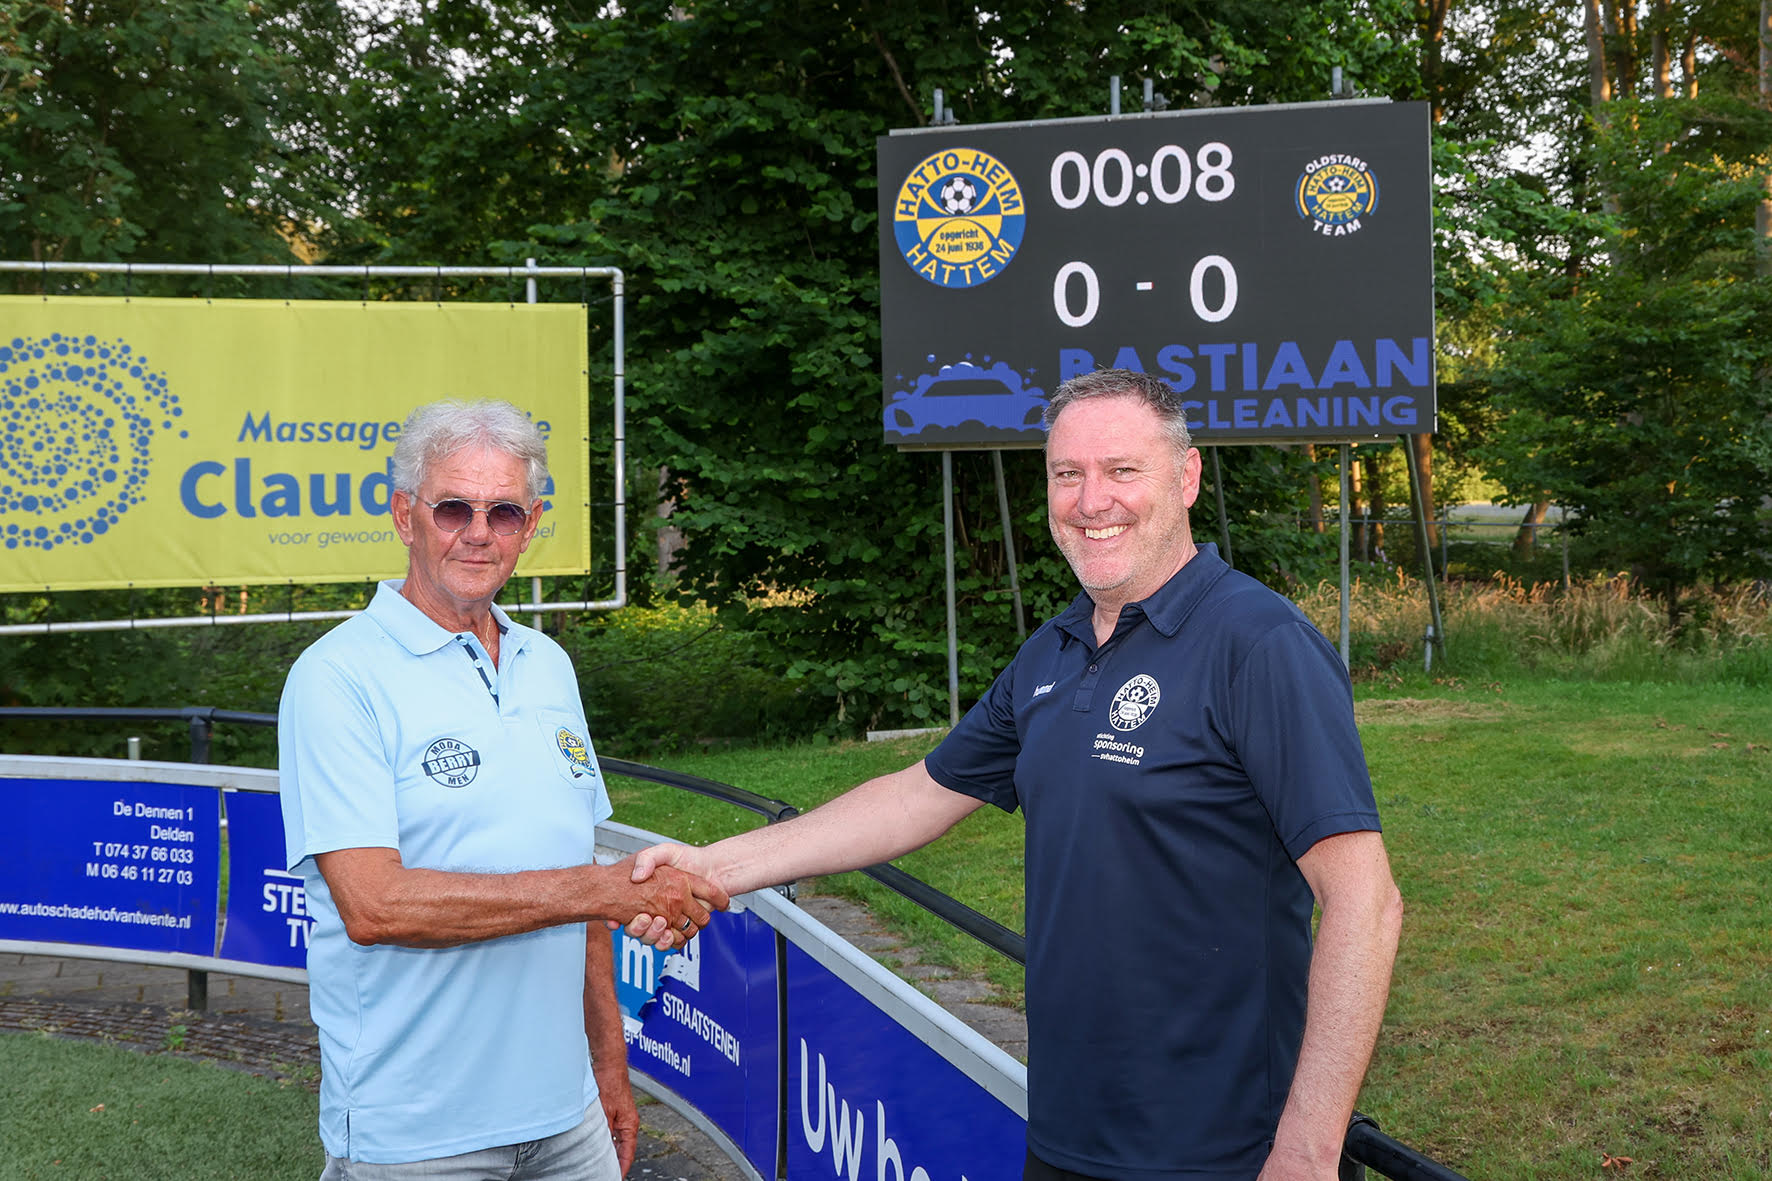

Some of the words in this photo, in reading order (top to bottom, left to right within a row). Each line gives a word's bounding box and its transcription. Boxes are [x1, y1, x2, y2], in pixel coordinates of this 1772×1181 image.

[1305, 154, 1367, 174] OLDSTARS
[898, 152, 1020, 217] HATTO-HEIM
[1050, 142, 1235, 209] 00:08
[1313, 219, 1361, 236] TEAM
[906, 238, 1015, 285] HATTEM
[1053, 260, 1100, 328] 0
[1189, 254, 1238, 323] 0
[268, 531, 312, 545] voor
[317, 530, 395, 549] gewoon
[1117, 677, 1158, 705] HATTO-HEIM
[1111, 709, 1147, 729] HATTEM
[430, 741, 461, 755] MODA
[1093, 739, 1145, 758] sponsoring
[427, 752, 474, 774] BERRY
[447, 774, 470, 785] MEN
[113, 801, 132, 816] De
[135, 803, 183, 820] Dennen
[186, 807, 193, 821] 1
[150, 824, 194, 843] Delden
[93, 842, 103, 856] T
[104, 843, 130, 858] 074
[132, 845, 149, 860] 37
[150, 846, 168, 862] 66
[169, 848, 194, 864] 033
[86, 863, 99, 877] M
[101, 864, 119, 879] 06
[120, 866, 138, 880] 46
[141, 867, 154, 881] 11
[157, 868, 174, 883] 27
[176, 870, 193, 885] 03
[0, 902, 191, 929] ww.autoschadehofvantwente.nl
[662, 991, 740, 1067] STRAATSTENEN
[800, 1037, 864, 1181] Uw
